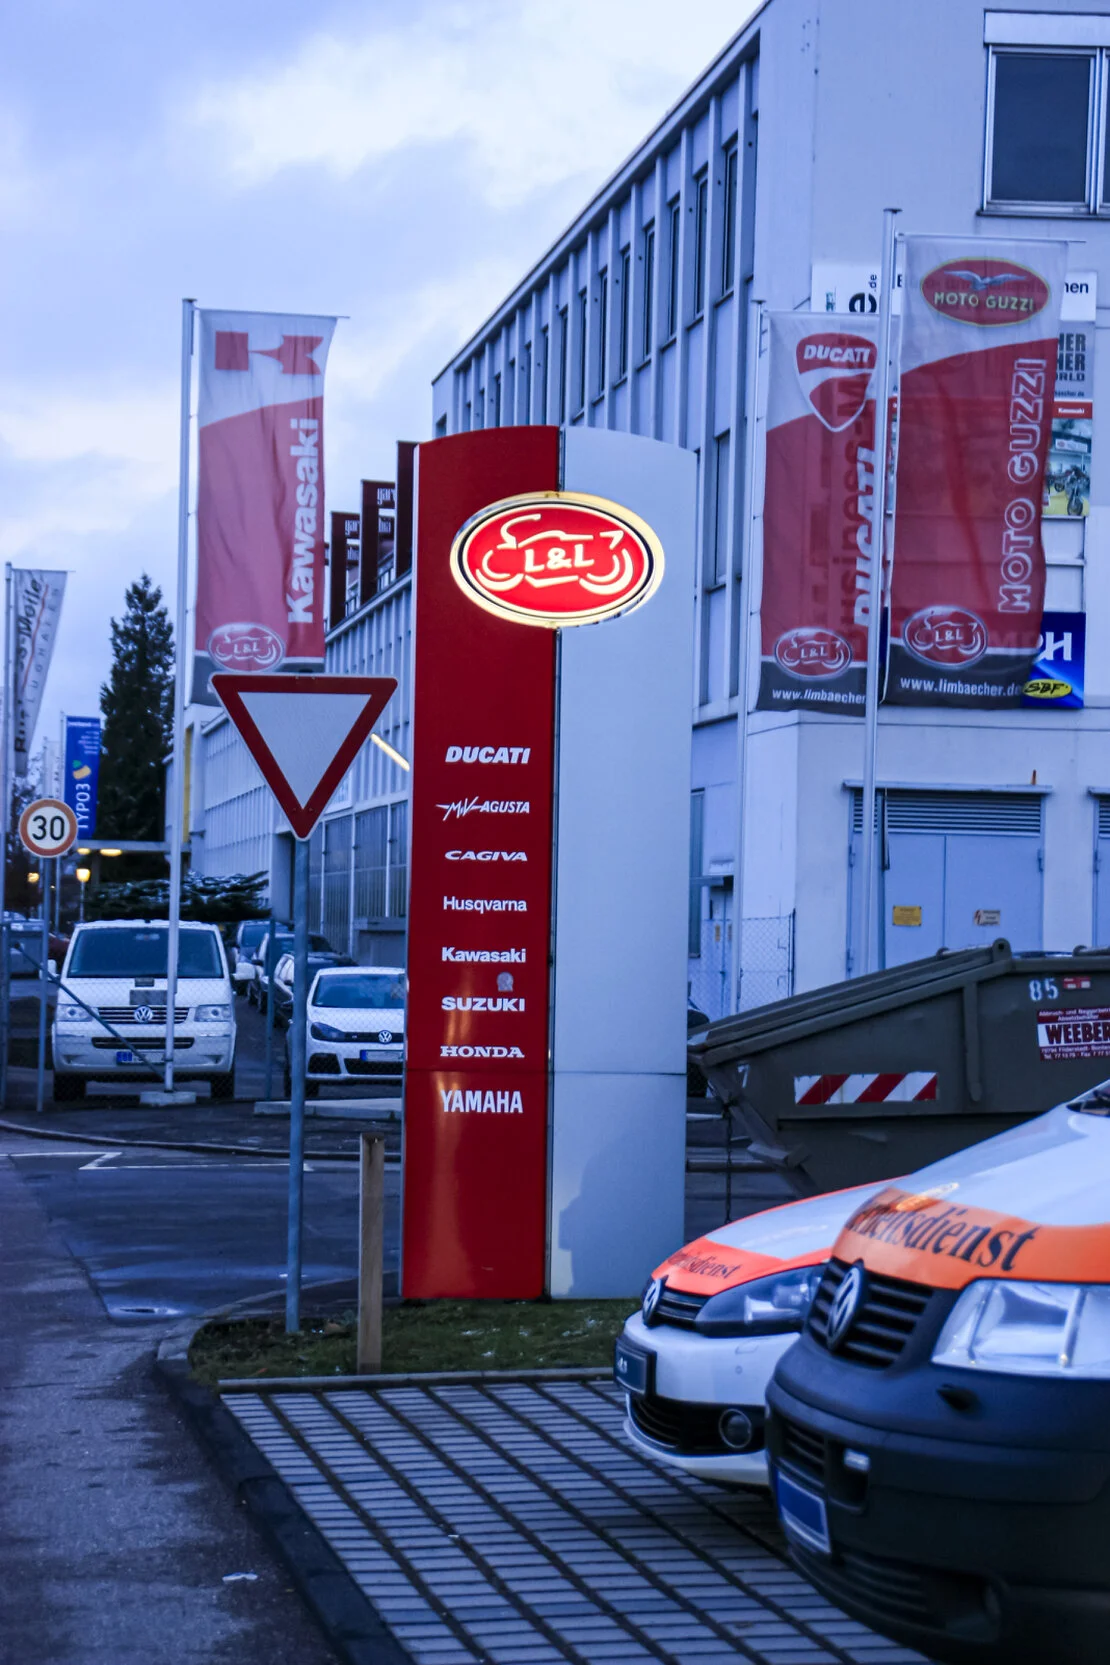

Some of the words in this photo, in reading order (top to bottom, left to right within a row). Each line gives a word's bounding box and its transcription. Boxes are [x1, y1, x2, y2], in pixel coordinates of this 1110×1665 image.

[934, 292, 979, 308] MOTO
[985, 295, 1034, 312] GUZZI
[804, 344, 871, 363] DUCATI
[1007, 358, 1047, 484] GUZZI
[288, 418, 319, 623] Kawasaki
[525, 544, 594, 572] L&L
[998, 498, 1036, 614] MOTO
[935, 630, 963, 643] L&L
[233, 641, 260, 654] L&L
[800, 644, 828, 659] L&L
[445, 745, 531, 764] DUCATI
[76, 783, 91, 829] TYPO3
[480, 800, 530, 814] AGUSTA
[33, 815, 65, 841] 30
[445, 850, 528, 861] CAGIVA
[443, 896, 527, 914] Husqvarna
[441, 947, 526, 963] Kawasaki
[1029, 978, 1059, 1001] 85
[441, 996, 525, 1012] SUZUKI
[1045, 1022, 1110, 1045] WEEBER
[440, 1045, 525, 1058] HONDA
[440, 1089, 524, 1114] YAMAHA
